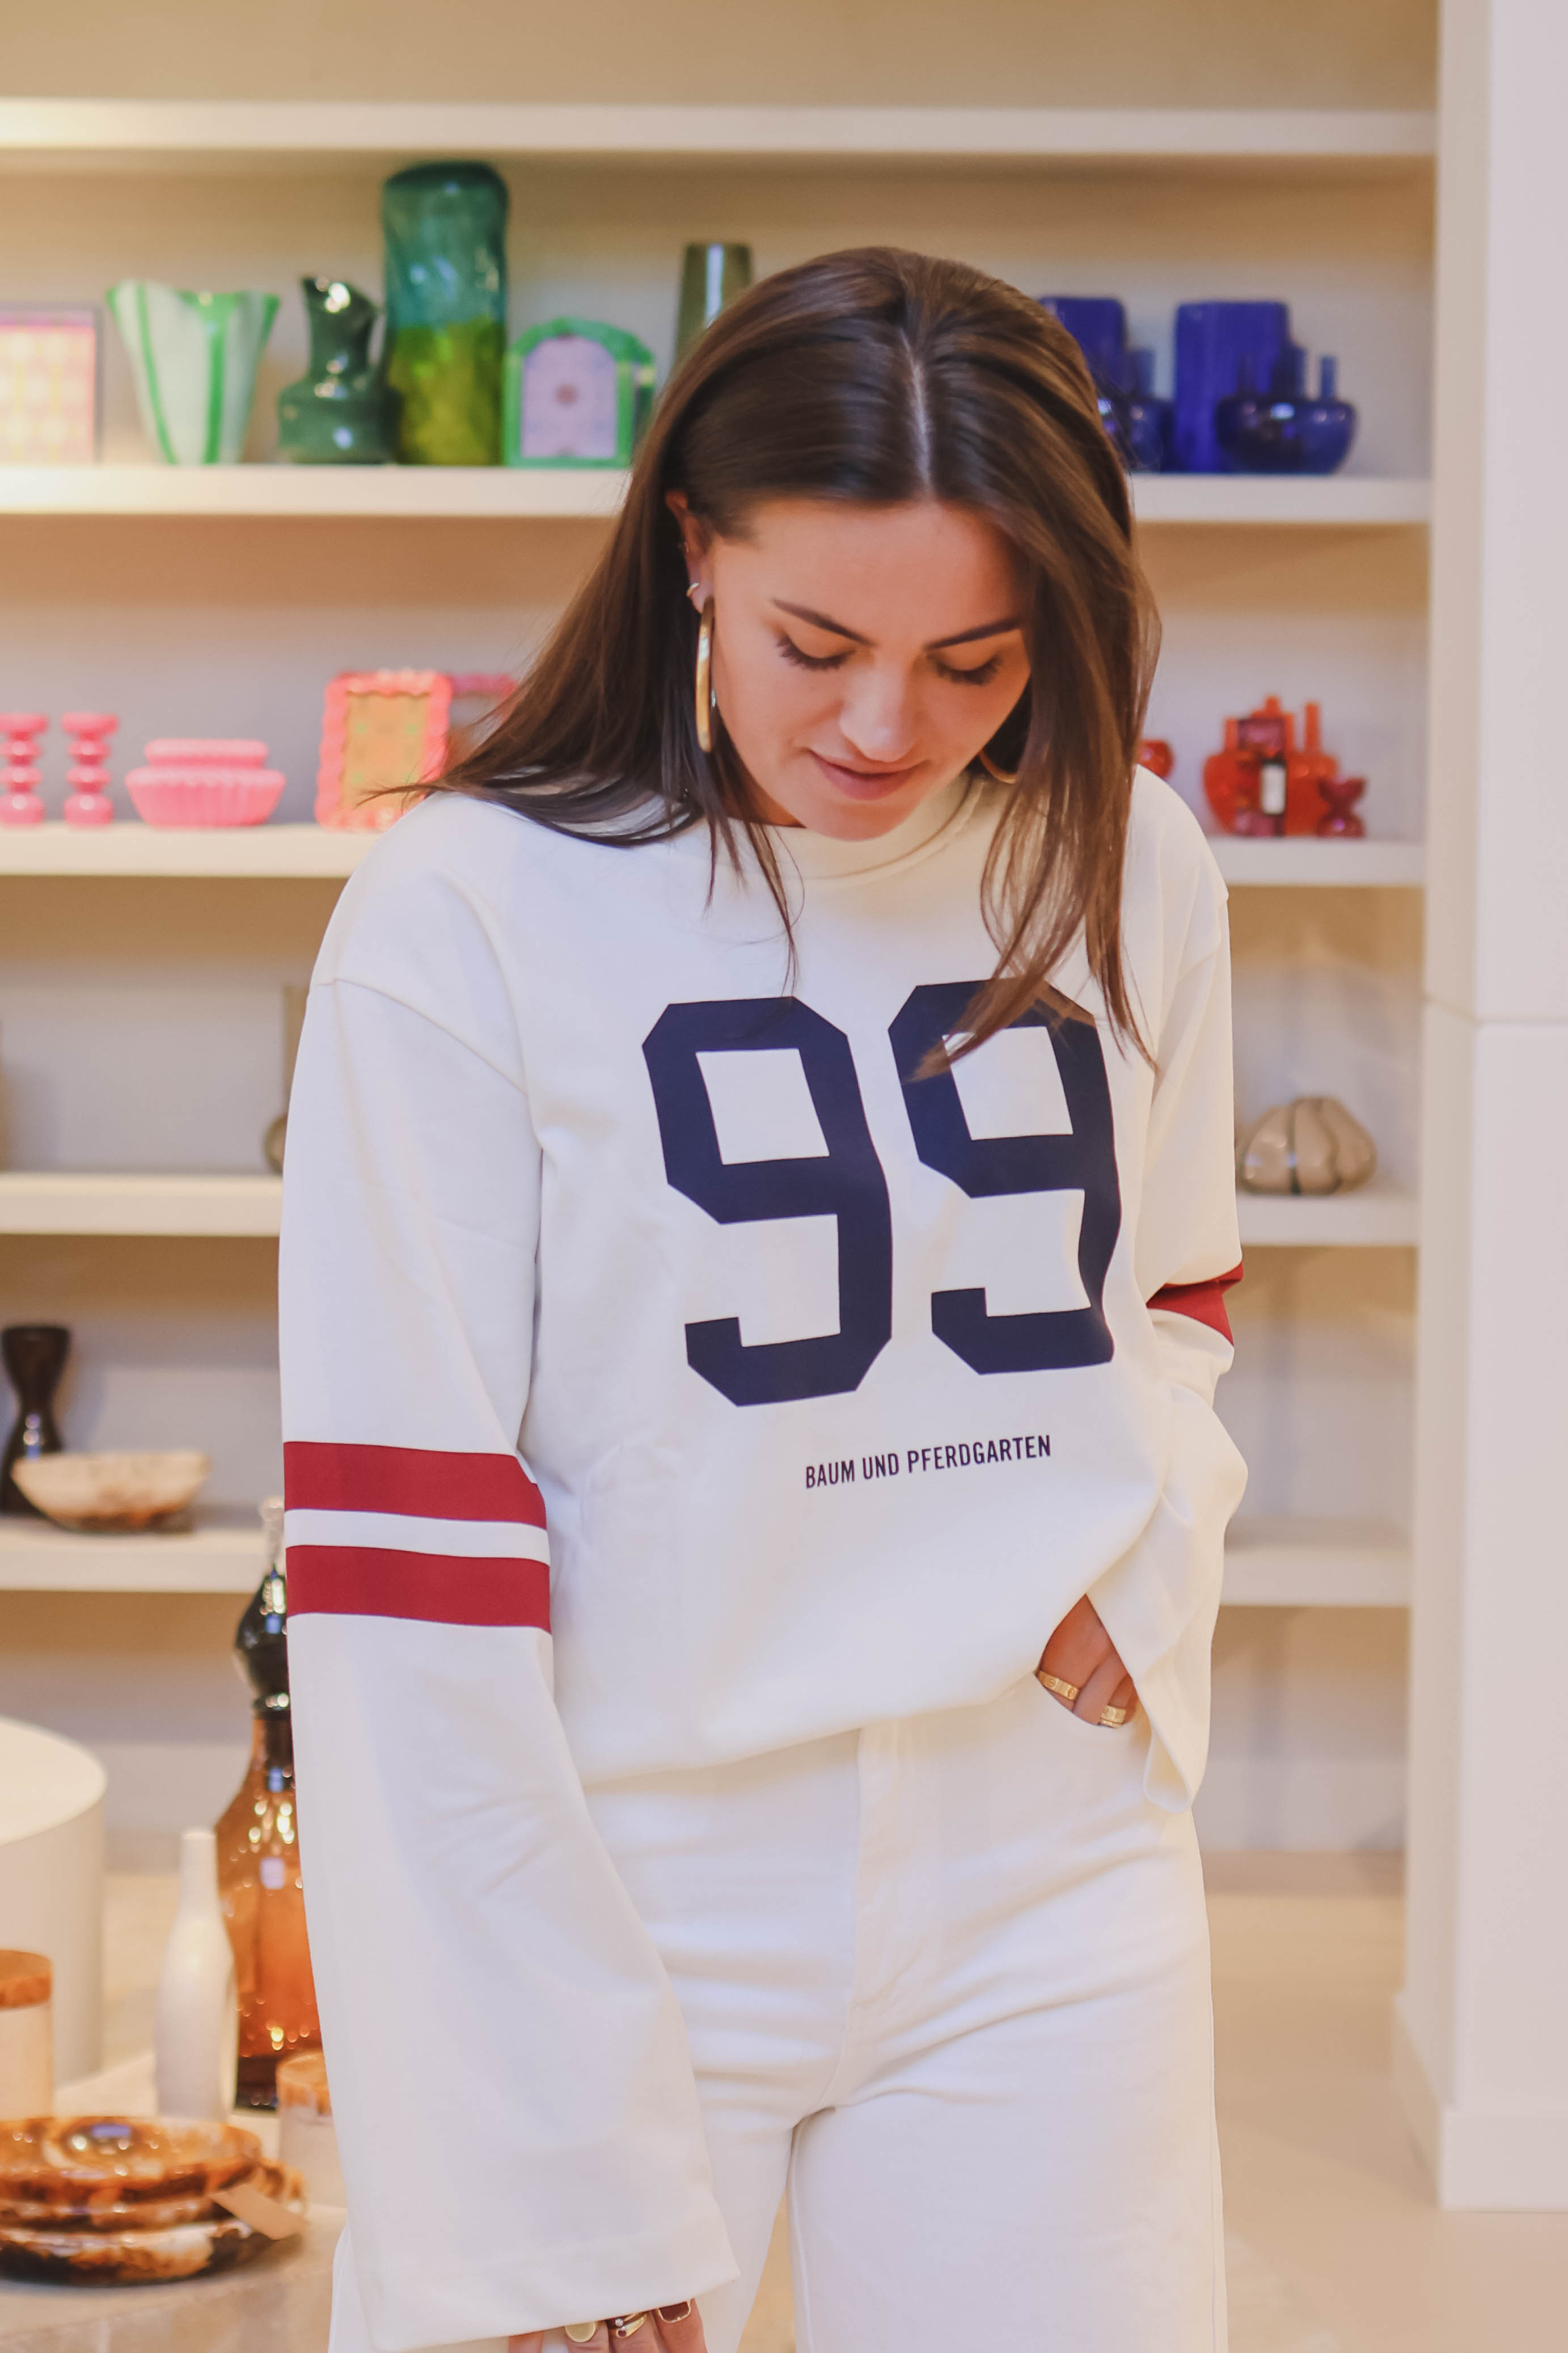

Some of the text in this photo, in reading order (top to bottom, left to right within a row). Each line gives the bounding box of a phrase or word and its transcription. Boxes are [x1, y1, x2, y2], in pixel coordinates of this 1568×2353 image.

[642, 977, 1121, 1407] 99
[806, 1435, 1051, 1488] BAUM UND PFERDGARTEN
